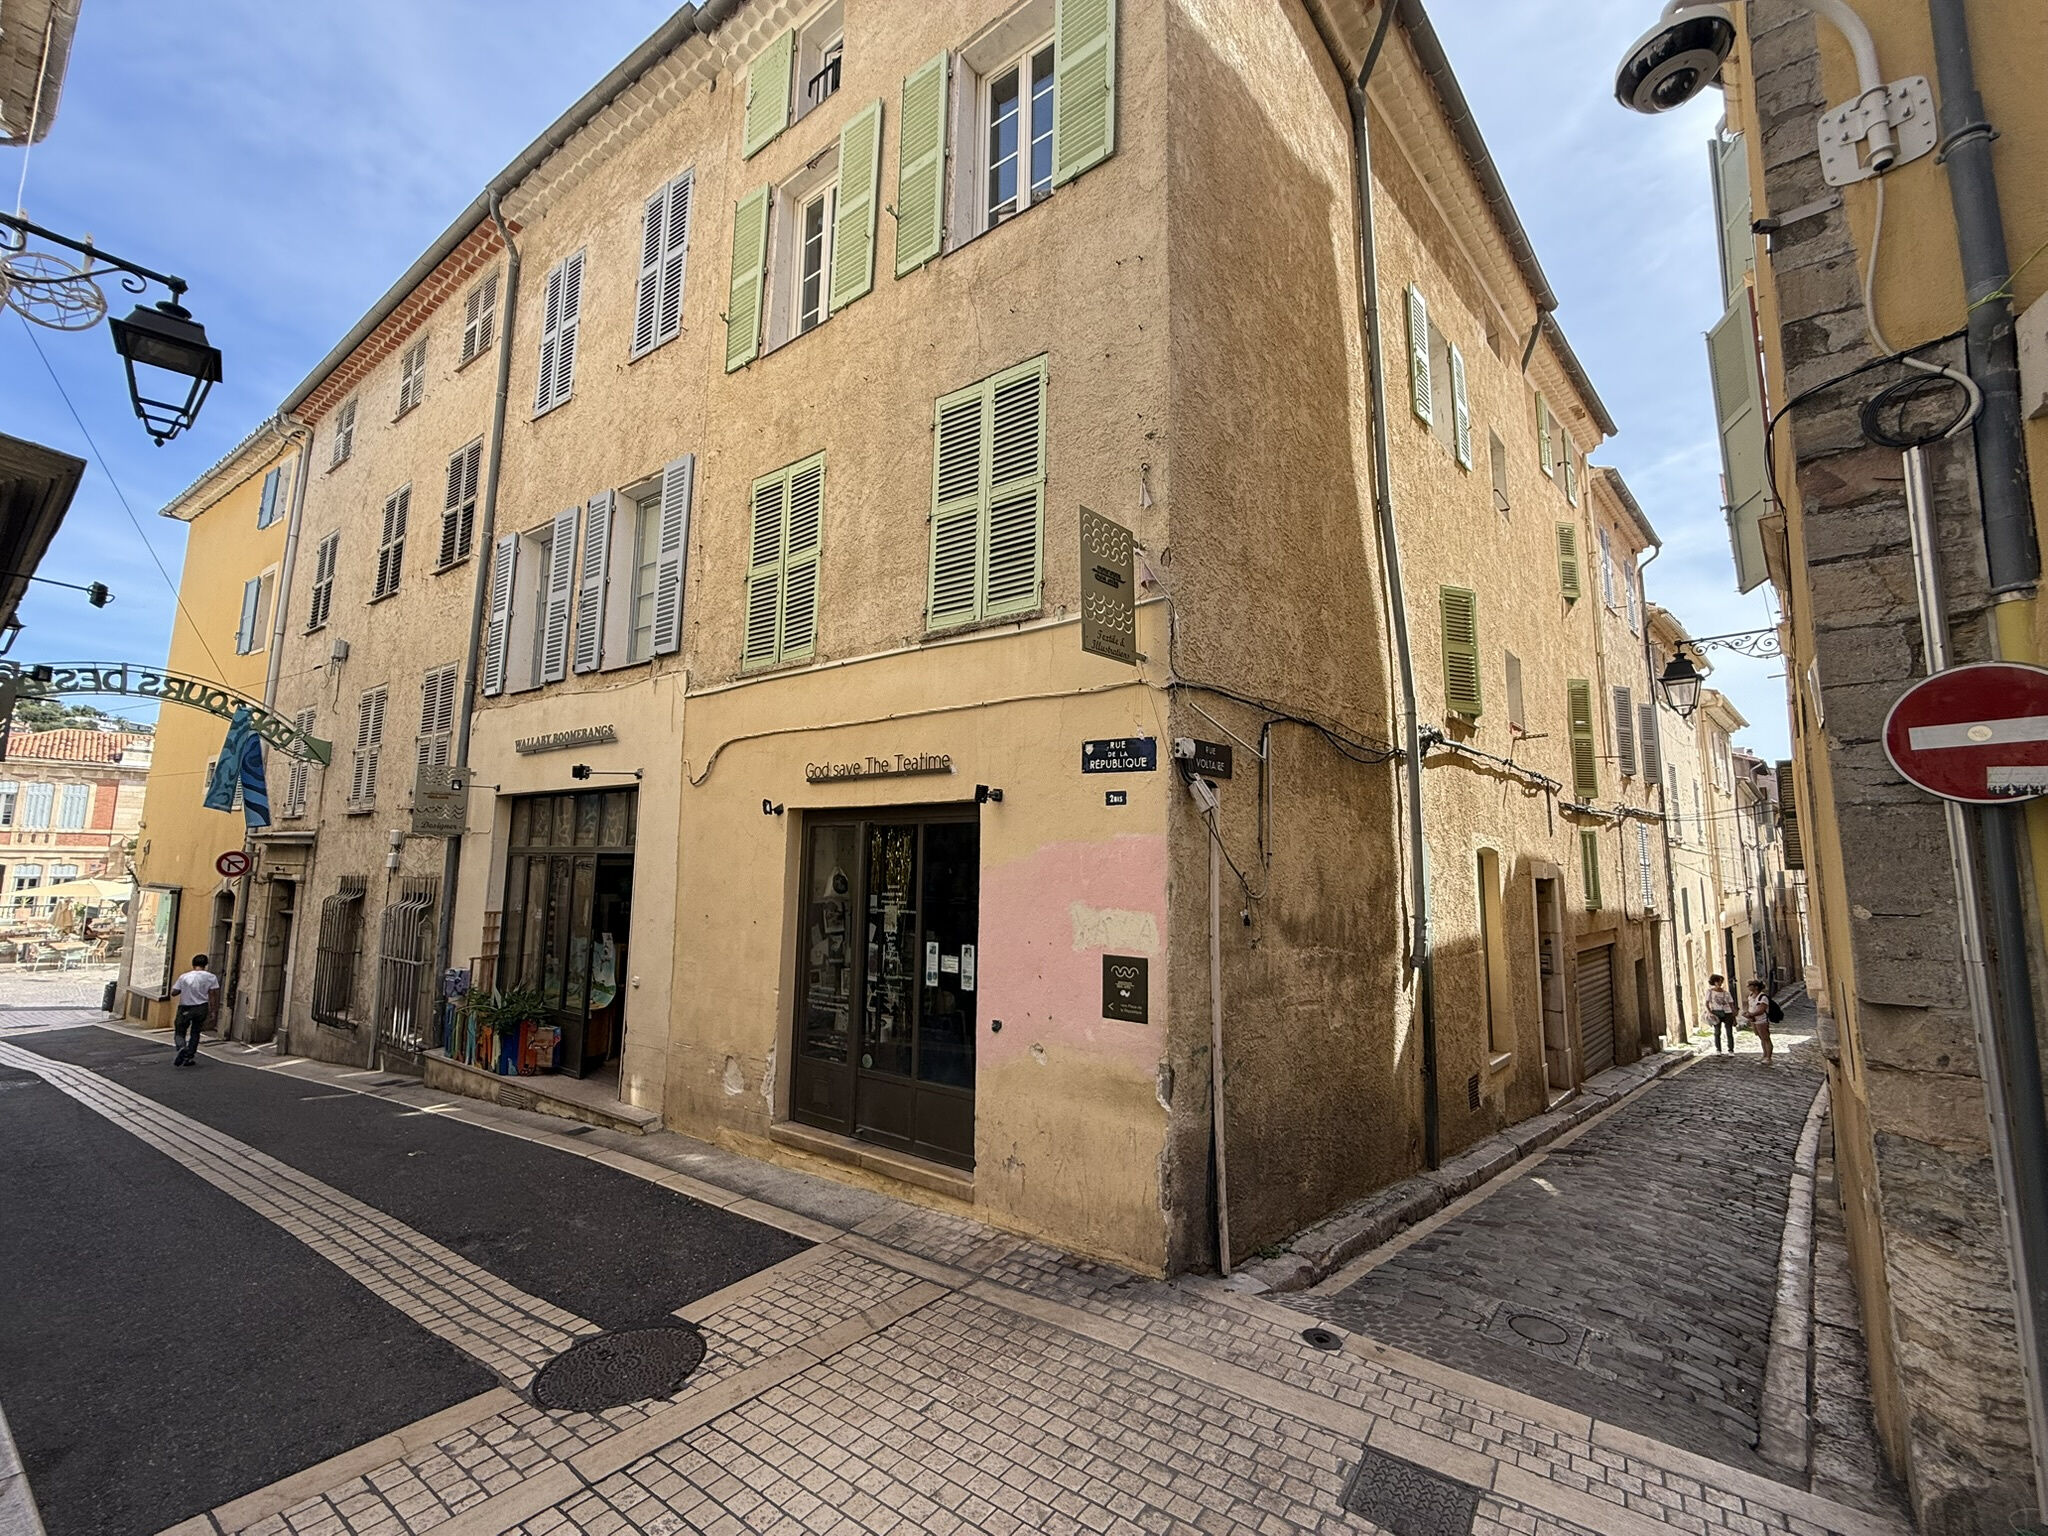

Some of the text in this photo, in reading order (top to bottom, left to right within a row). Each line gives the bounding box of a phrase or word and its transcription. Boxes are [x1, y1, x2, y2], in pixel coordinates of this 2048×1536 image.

[515, 723, 615, 750] WALLABY BOOMERANGS
[1109, 740, 1126, 749] RUE
[805, 751, 951, 779] God save The Teatime
[1089, 756, 1148, 770] RÉPUBLIQUE
